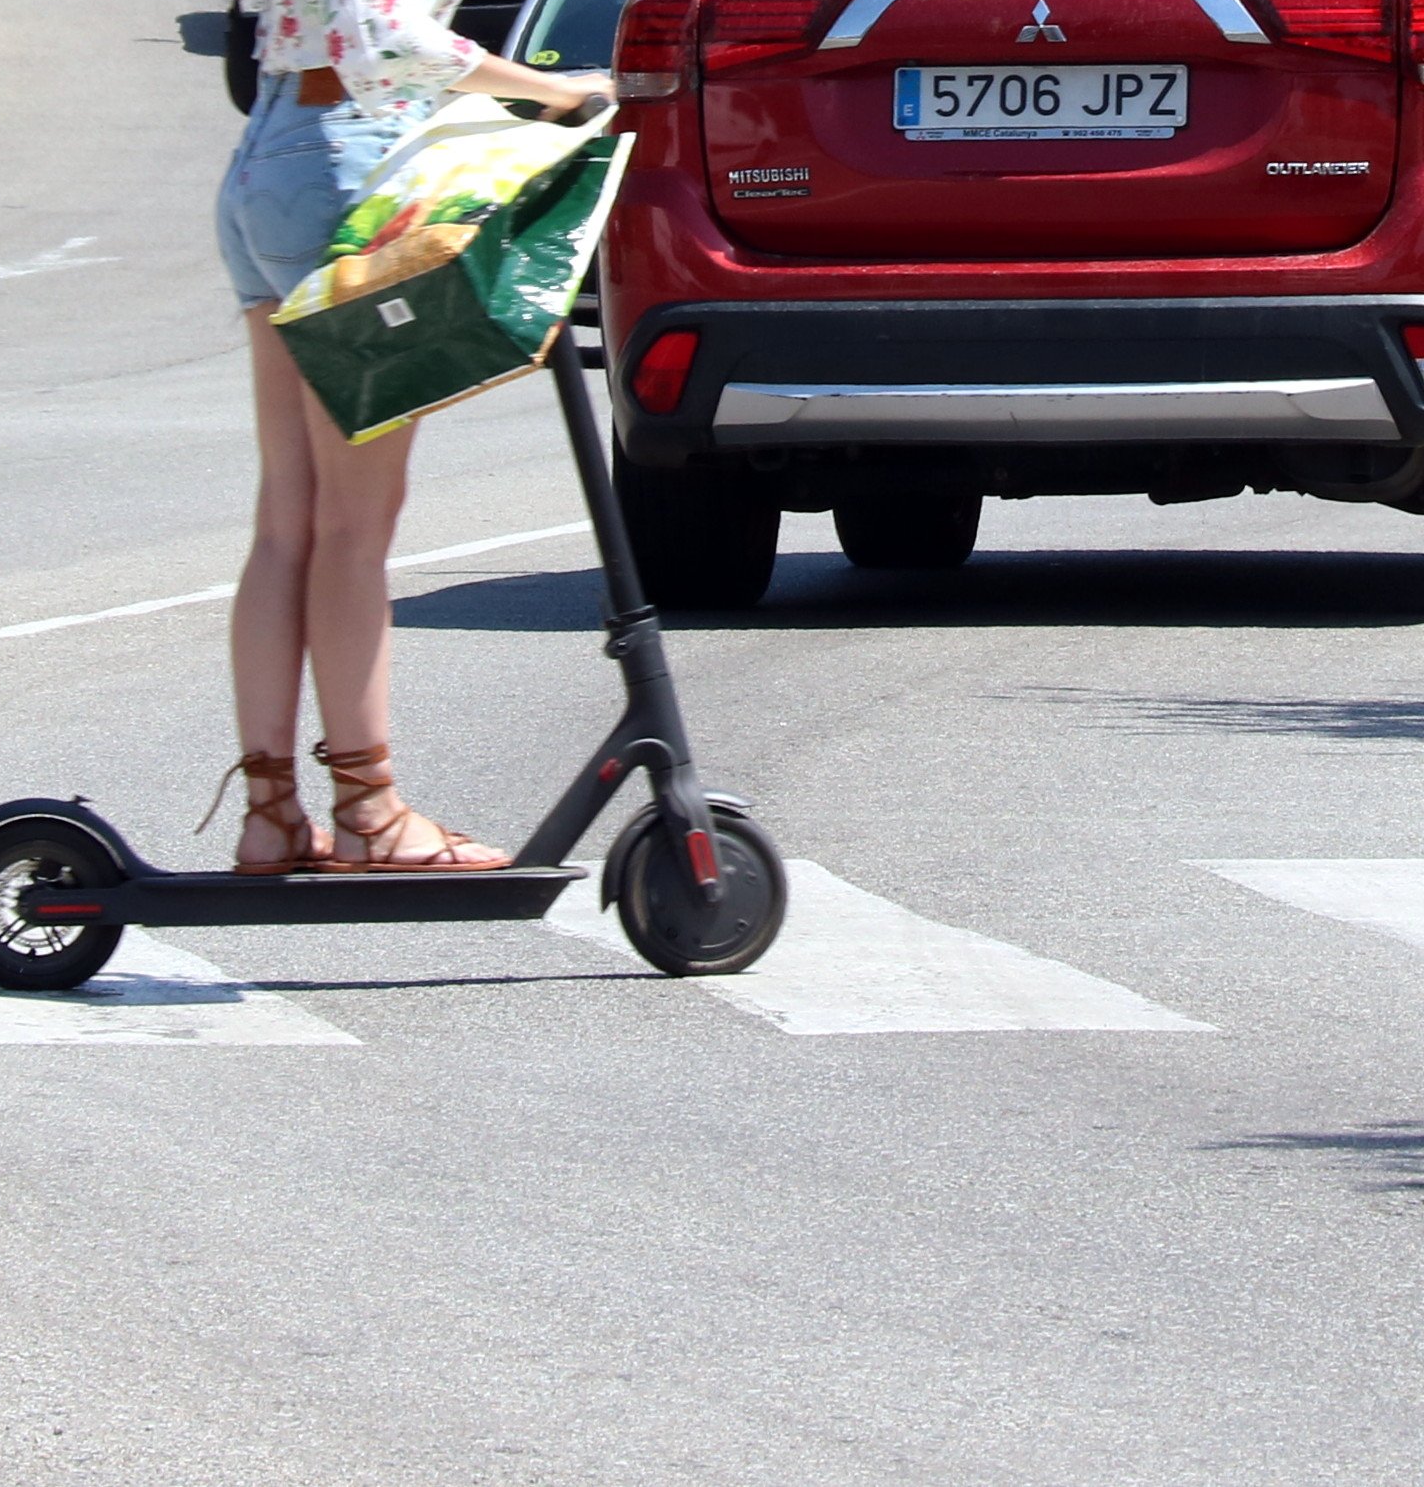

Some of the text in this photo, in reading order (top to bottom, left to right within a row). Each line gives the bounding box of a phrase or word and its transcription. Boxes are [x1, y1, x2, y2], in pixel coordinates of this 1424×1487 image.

[932, 73, 1178, 117] 5706 JPZ
[903, 104, 914, 116] E
[962, 129, 1038, 139] MMCE Catalunya
[1266, 162, 1371, 175] OUTLANDER
[728, 168, 810, 184] MITSUBISHI
